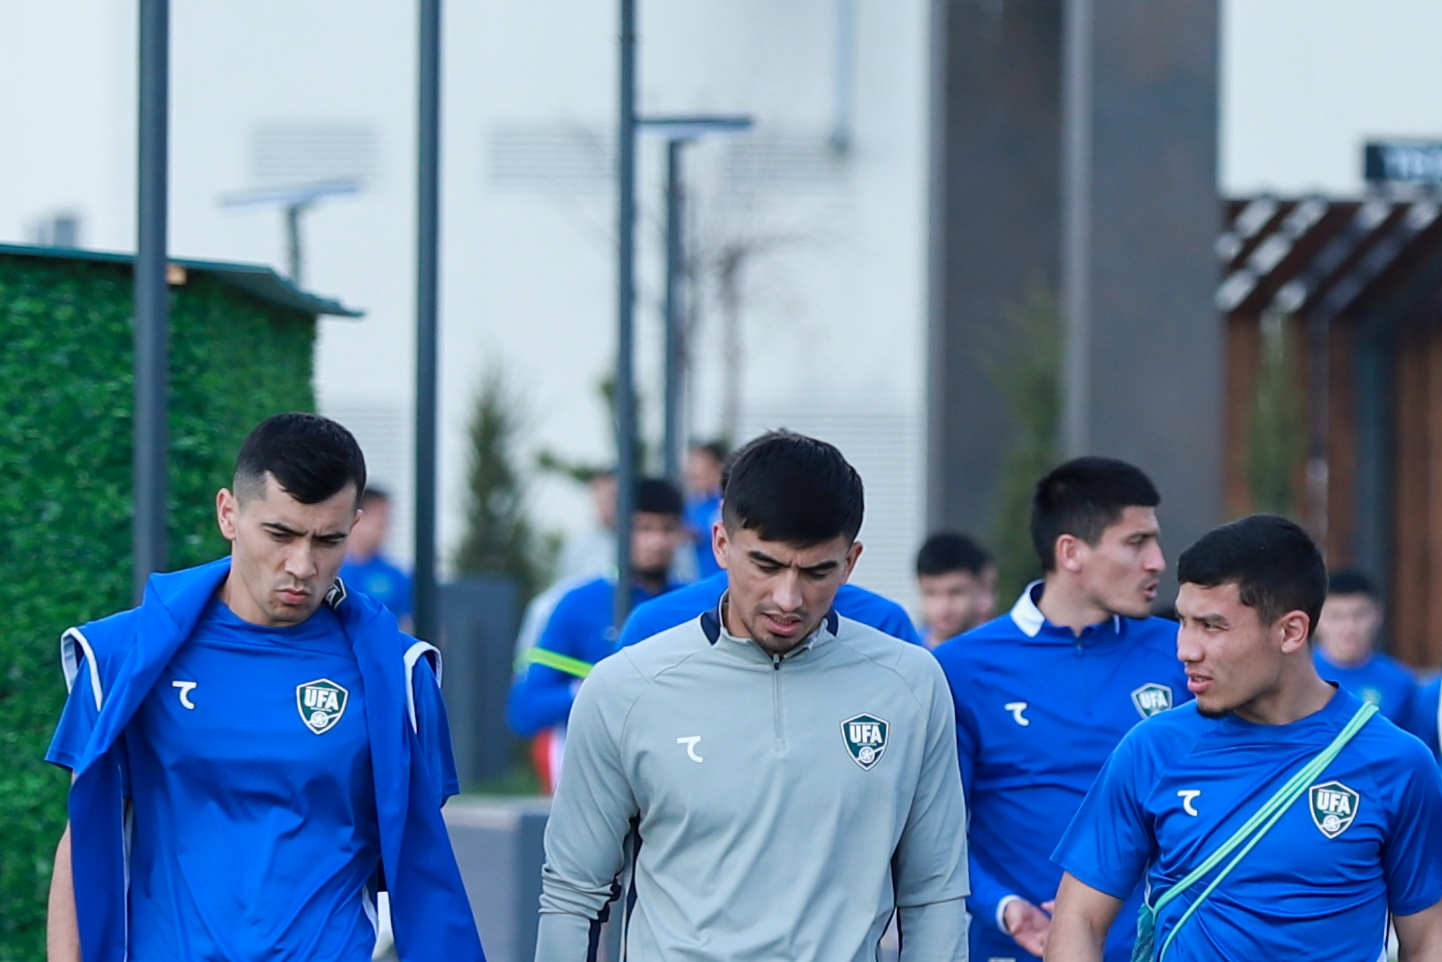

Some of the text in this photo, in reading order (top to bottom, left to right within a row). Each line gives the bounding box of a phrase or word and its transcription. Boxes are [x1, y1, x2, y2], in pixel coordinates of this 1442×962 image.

[304, 688, 340, 711] UFA
[1139, 690, 1169, 709] UFA
[849, 725, 883, 743] UFA
[1317, 791, 1351, 815] UFA
